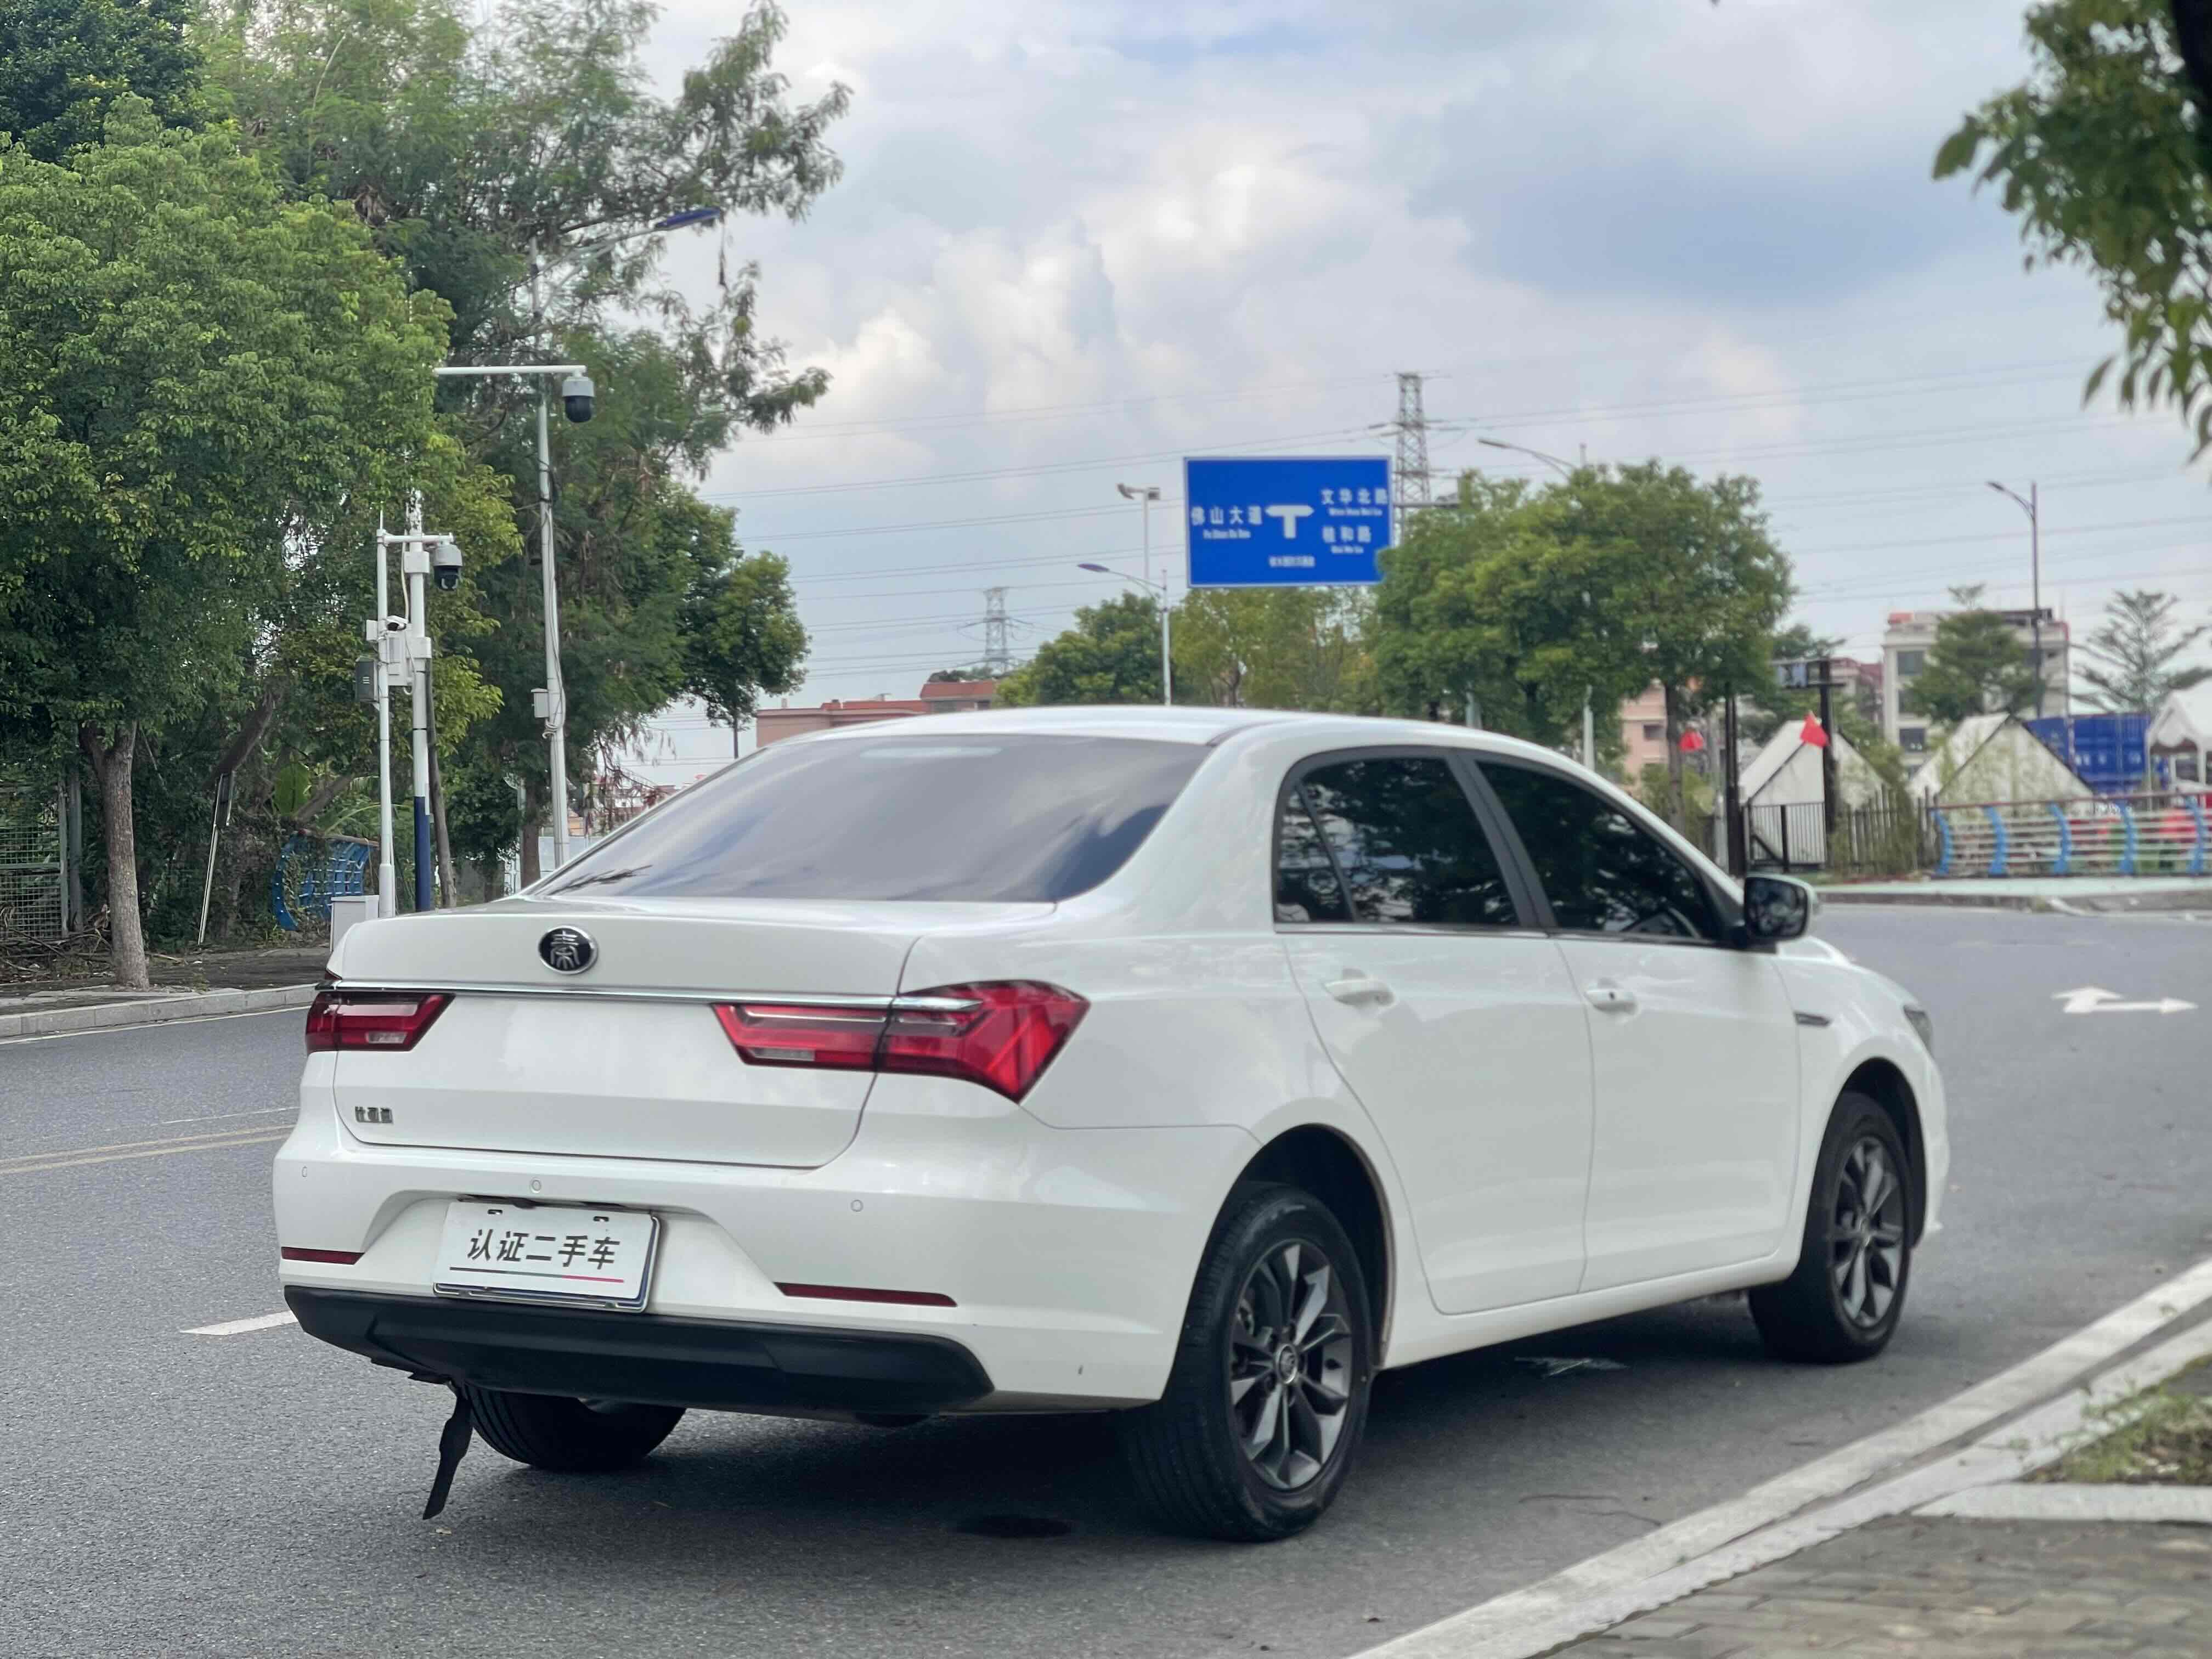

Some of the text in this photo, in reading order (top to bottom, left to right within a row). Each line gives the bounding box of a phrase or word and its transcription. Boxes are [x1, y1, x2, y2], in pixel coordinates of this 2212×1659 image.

[467, 1228, 620, 1270] 认证二手车
